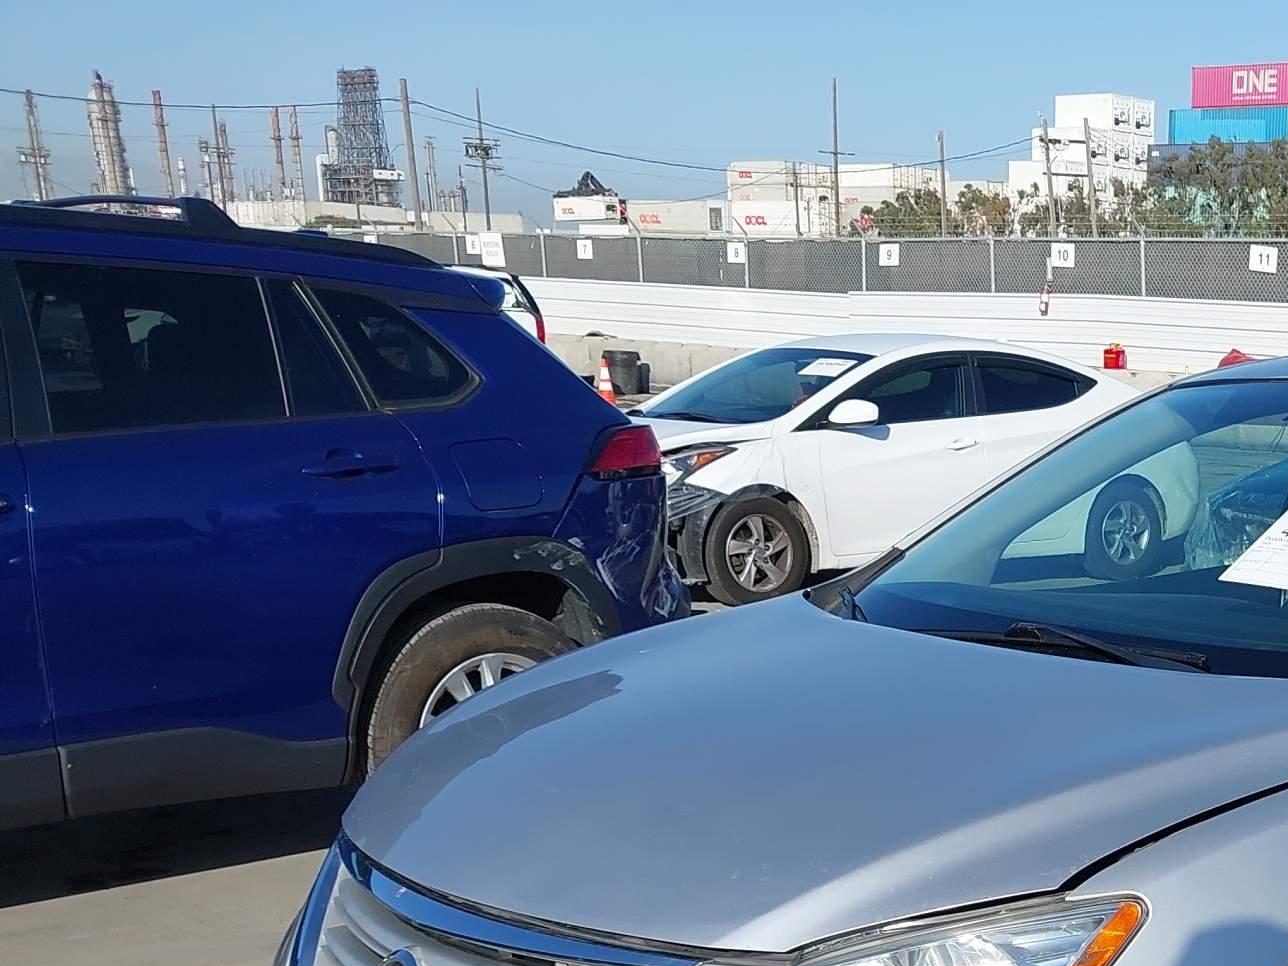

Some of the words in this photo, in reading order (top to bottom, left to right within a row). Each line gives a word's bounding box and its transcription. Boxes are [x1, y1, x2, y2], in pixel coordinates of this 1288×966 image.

[1232, 69, 1278, 94] ONE
[745, 215, 768, 225] OOCL
[886, 249, 892, 261] 9
[1057, 249, 1069, 262] 10
[1258, 252, 1271, 266] 11
